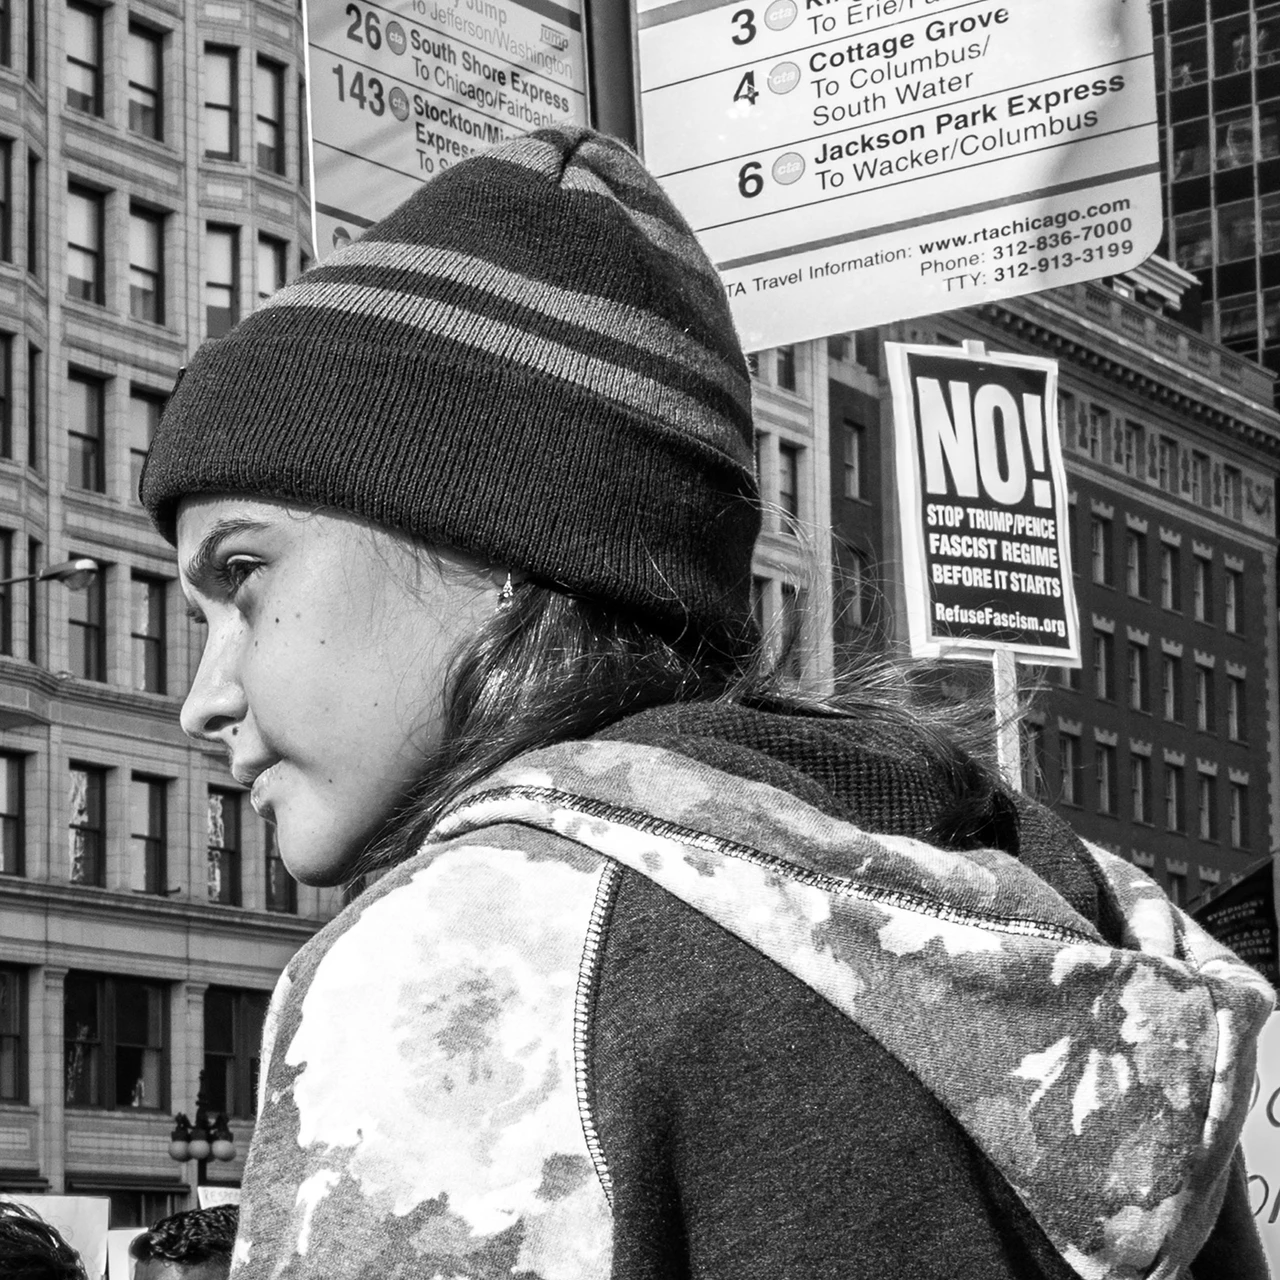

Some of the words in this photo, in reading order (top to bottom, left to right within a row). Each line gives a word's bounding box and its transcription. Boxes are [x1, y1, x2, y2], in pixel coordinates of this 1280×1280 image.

[345, 3, 382, 51] 26
[730, 9, 758, 46] 3
[769, 8, 794, 22] cta
[807, 14, 837, 35] To
[808, 32, 915, 74] Cottage
[925, 7, 1010, 42] Grove
[430, 3, 573, 79] Jefferson/Washington
[332, 63, 386, 117] 143
[410, 28, 457, 66] South
[462, 50, 507, 86] Shore
[511, 70, 570, 113] Express
[411, 56, 430, 81] To
[434, 65, 556, 127] Chicago/Fairban
[733, 69, 760, 106] 4
[772, 70, 797, 85] cta
[810, 77, 840, 100] To
[849, 34, 992, 90] Columbus/
[413, 94, 511, 145] Stockton/Mi
[812, 92, 888, 128] South
[895, 69, 975, 106] Water
[814, 125, 927, 165] Jackson
[934, 103, 999, 135] Park
[1006, 72, 1126, 118] Express
[416, 148, 435, 174] To
[776, 159, 802, 177] cta
[816, 170, 846, 192] To
[851, 107, 1100, 183] Wacker/Columbus
[738, 160, 765, 200] 6
[918, 196, 1132, 257] www.rtachicago.com
[920, 250, 987, 278] Phone:
[991, 216, 1133, 262] 312-836-7000
[725, 281, 747, 298] TA
[752, 268, 804, 297] Travel
[808, 246, 914, 281] Information:
[942, 270, 988, 294] TTY:
[993, 238, 1135, 284] 312-913-3199
[915, 375, 1053, 510] NO!
[926, 502, 965, 528] STOP
[966, 506, 1057, 541] TRUMP/PENCE
[928, 532, 998, 561] FASCIST
[1000, 540, 1059, 569] REGIME
[931, 562, 994, 589] BEFORE
[993, 569, 1009, 590] IT
[1009, 571, 1062, 599] STARTS
[934, 601, 1068, 638] RefuseFascism.org
